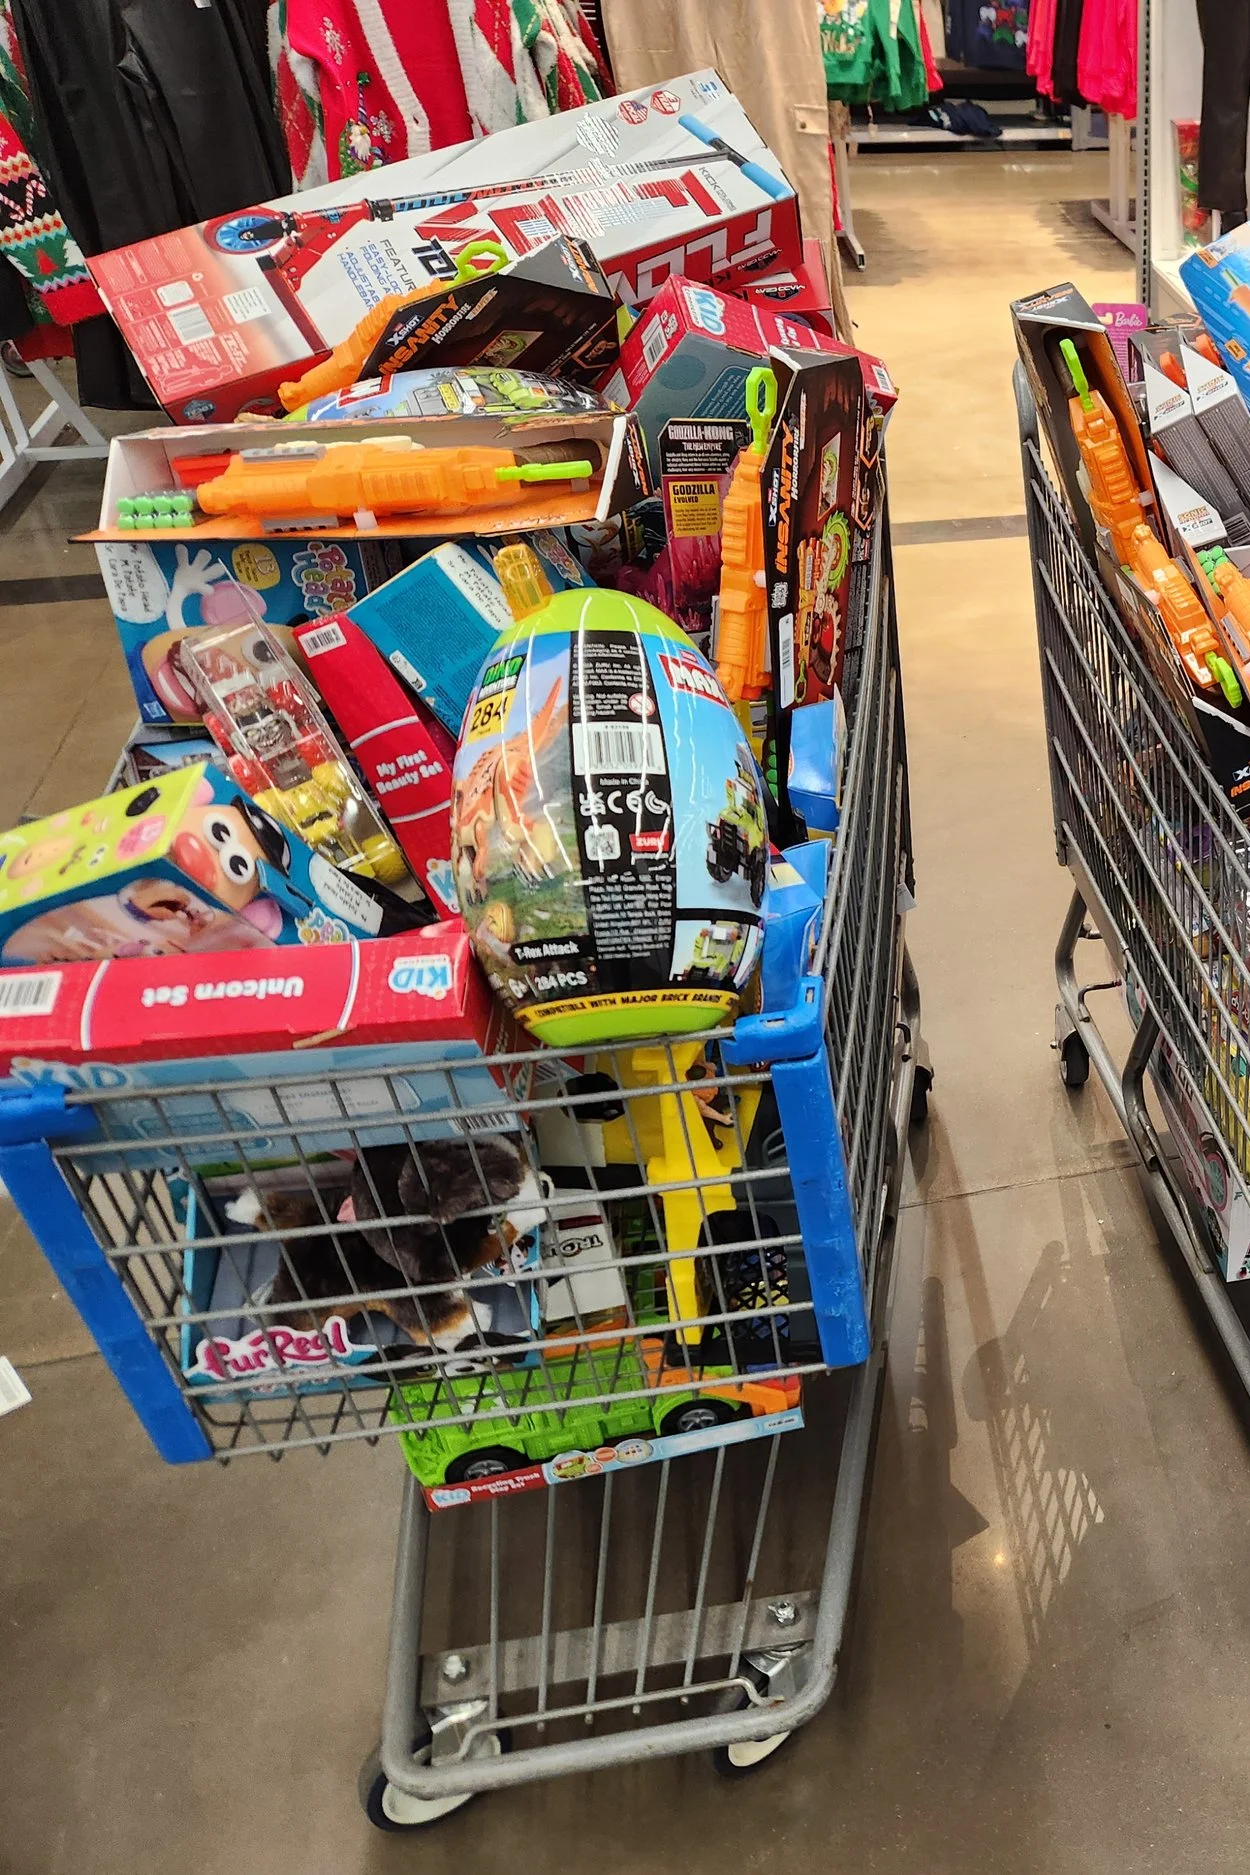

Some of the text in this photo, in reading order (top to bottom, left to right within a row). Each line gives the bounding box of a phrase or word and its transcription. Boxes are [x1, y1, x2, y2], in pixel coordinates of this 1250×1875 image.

[360, 245, 386, 286] FOLDING
[368, 243, 404, 294] EASY-LOC
[380, 239, 416, 292] FEATUR
[411, 238, 460, 282] 10
[346, 251, 381, 303] ADJUSTAB
[692, 286, 725, 333] KID
[1115, 311, 1143, 327] Barbie
[672, 483, 716, 496] GODZILLA
[673, 496, 699, 504] EVOLVED
[769, 468, 780, 527] XSHOT
[775, 420, 793, 574] INSANITY
[483, 656, 525, 687] DINO
[669, 659, 722, 698] MAX
[469, 694, 507, 733] 284
[375, 749, 428, 777] My First
[375, 761, 444, 795] Beauty Set
[635, 836, 664, 849] ZURU
[543, 940, 580, 957] Attack
[141, 976, 304, 1008] Unicorn Set
[390, 965, 448, 991] KID
[559, 971, 589, 988] PCS
[589, 995, 617, 1008] WITH
[620, 993, 658, 1006] MAJOR
[661, 992, 689, 1003] BRICK
